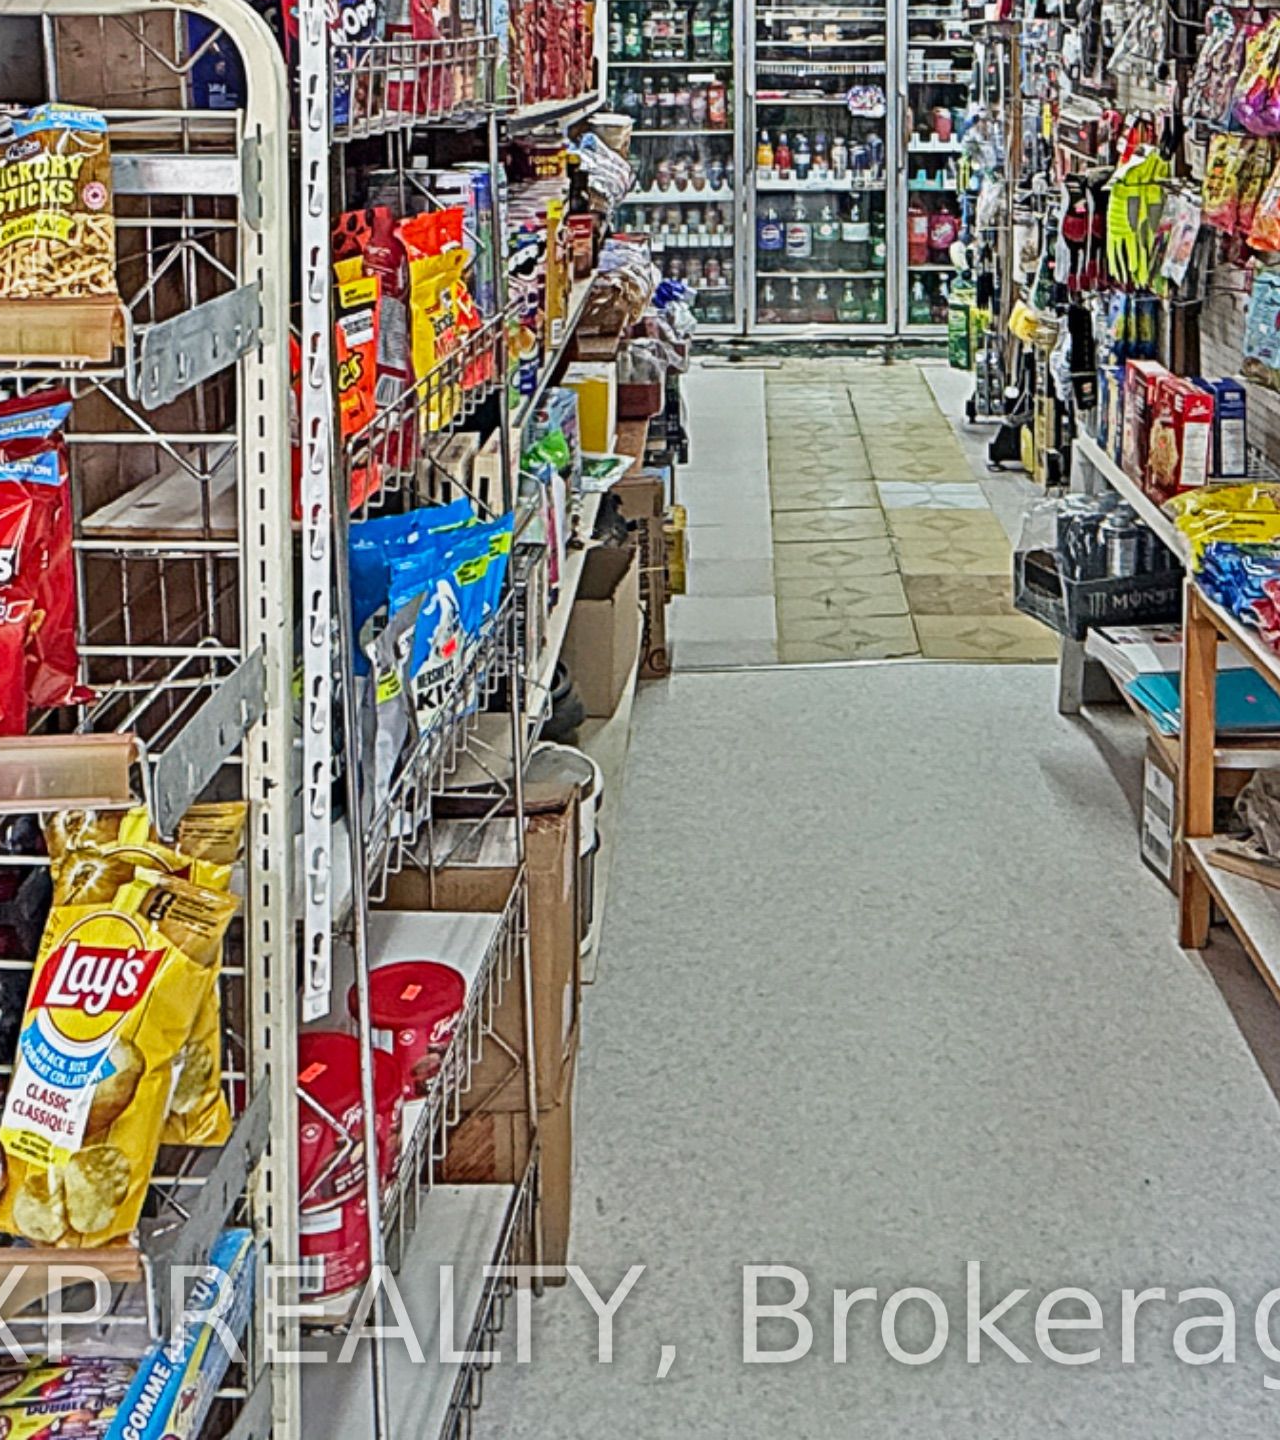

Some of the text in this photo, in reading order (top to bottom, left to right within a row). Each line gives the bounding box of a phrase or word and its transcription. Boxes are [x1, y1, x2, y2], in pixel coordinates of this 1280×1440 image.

[44, 940, 146, 1015] Lay's
[24, 1082, 72, 1113] CLASSIC
[10, 1099, 77, 1137] CLASSIQUE
